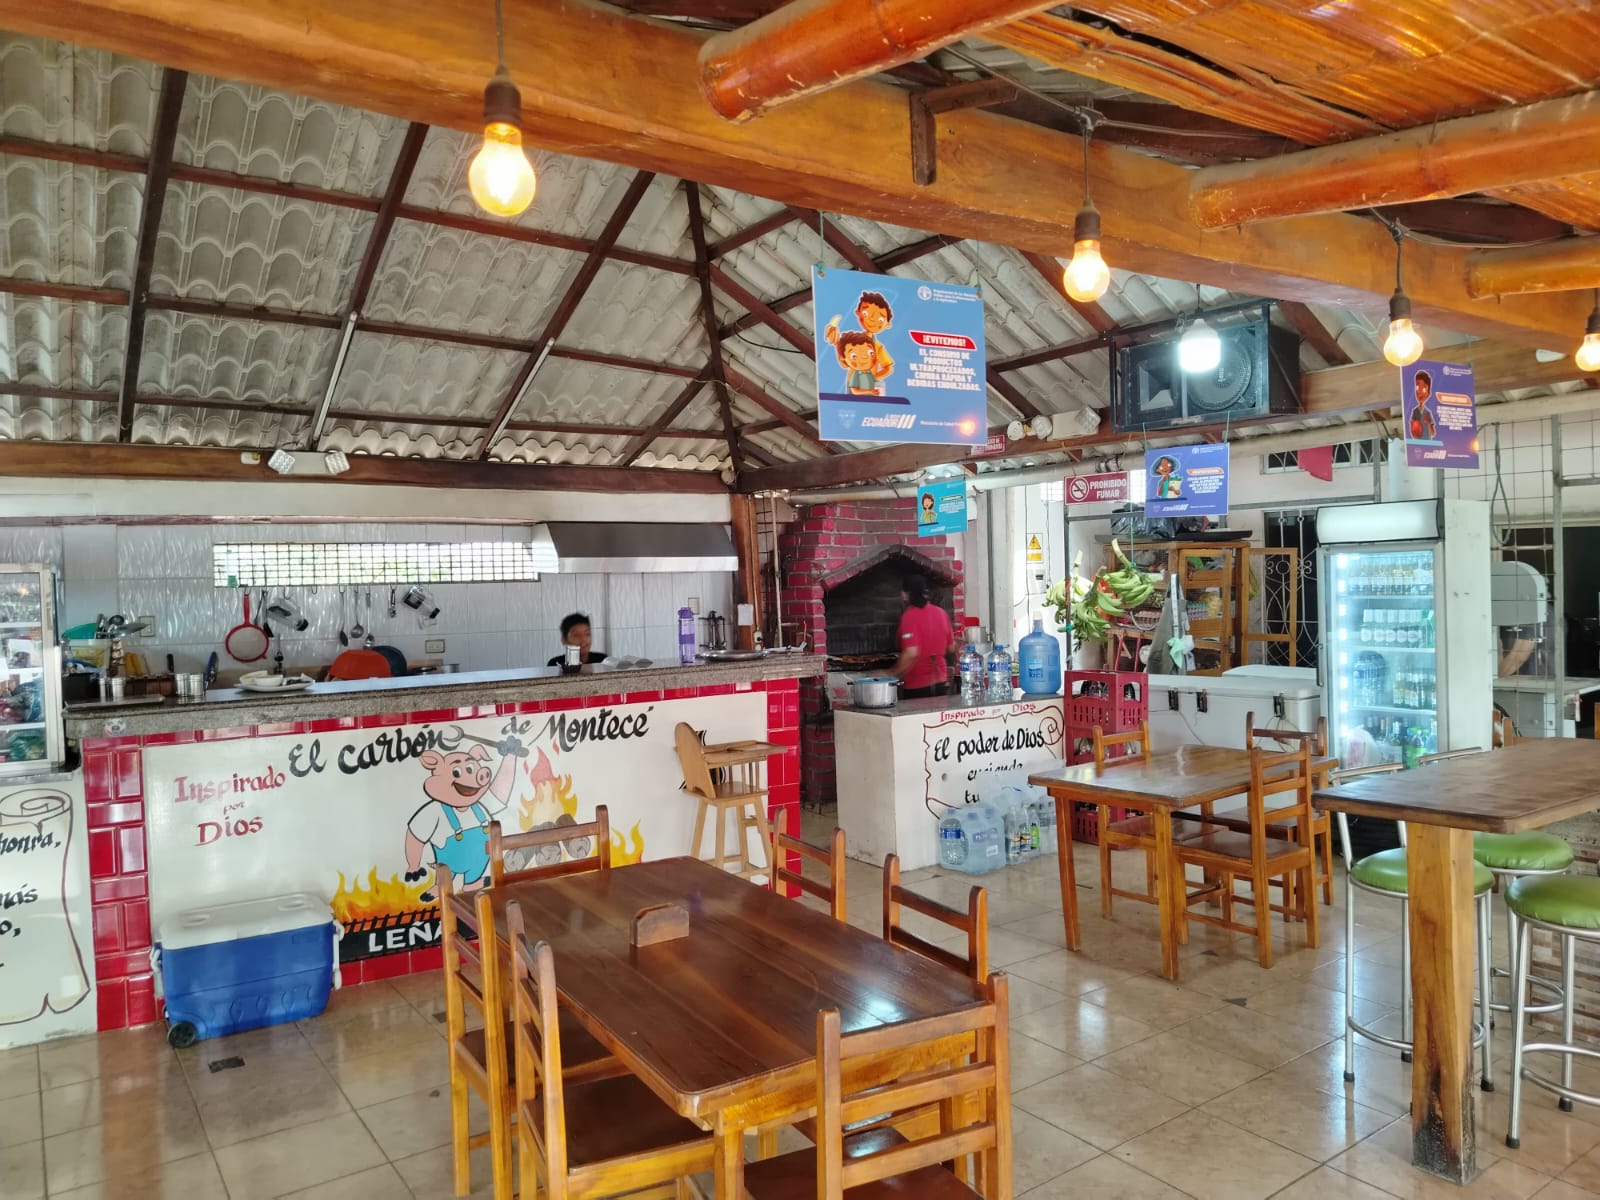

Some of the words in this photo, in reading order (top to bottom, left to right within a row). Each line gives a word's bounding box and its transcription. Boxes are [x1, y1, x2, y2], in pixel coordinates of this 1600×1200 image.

[923, 334, 967, 347] ¡EVITEMOS!
[919, 348, 928, 356] EL
[1089, 478, 1127, 490] PROHIBIDO
[1096, 489, 1120, 499] FUMAR
[940, 708, 986, 722] Inspirado
[1012, 702, 1037, 714] Dios
[288, 738, 328, 777] El
[338, 724, 461, 774] carbón
[501, 716, 533, 735] de
[934, 736, 951, 762] El
[957, 731, 1000, 764] poder
[1001, 728, 1015, 750] de
[1016, 727, 1046, 750] Dios
[174, 765, 286, 803] Inspirado
[223, 801, 245, 815] por
[194, 816, 264, 847] Dios
